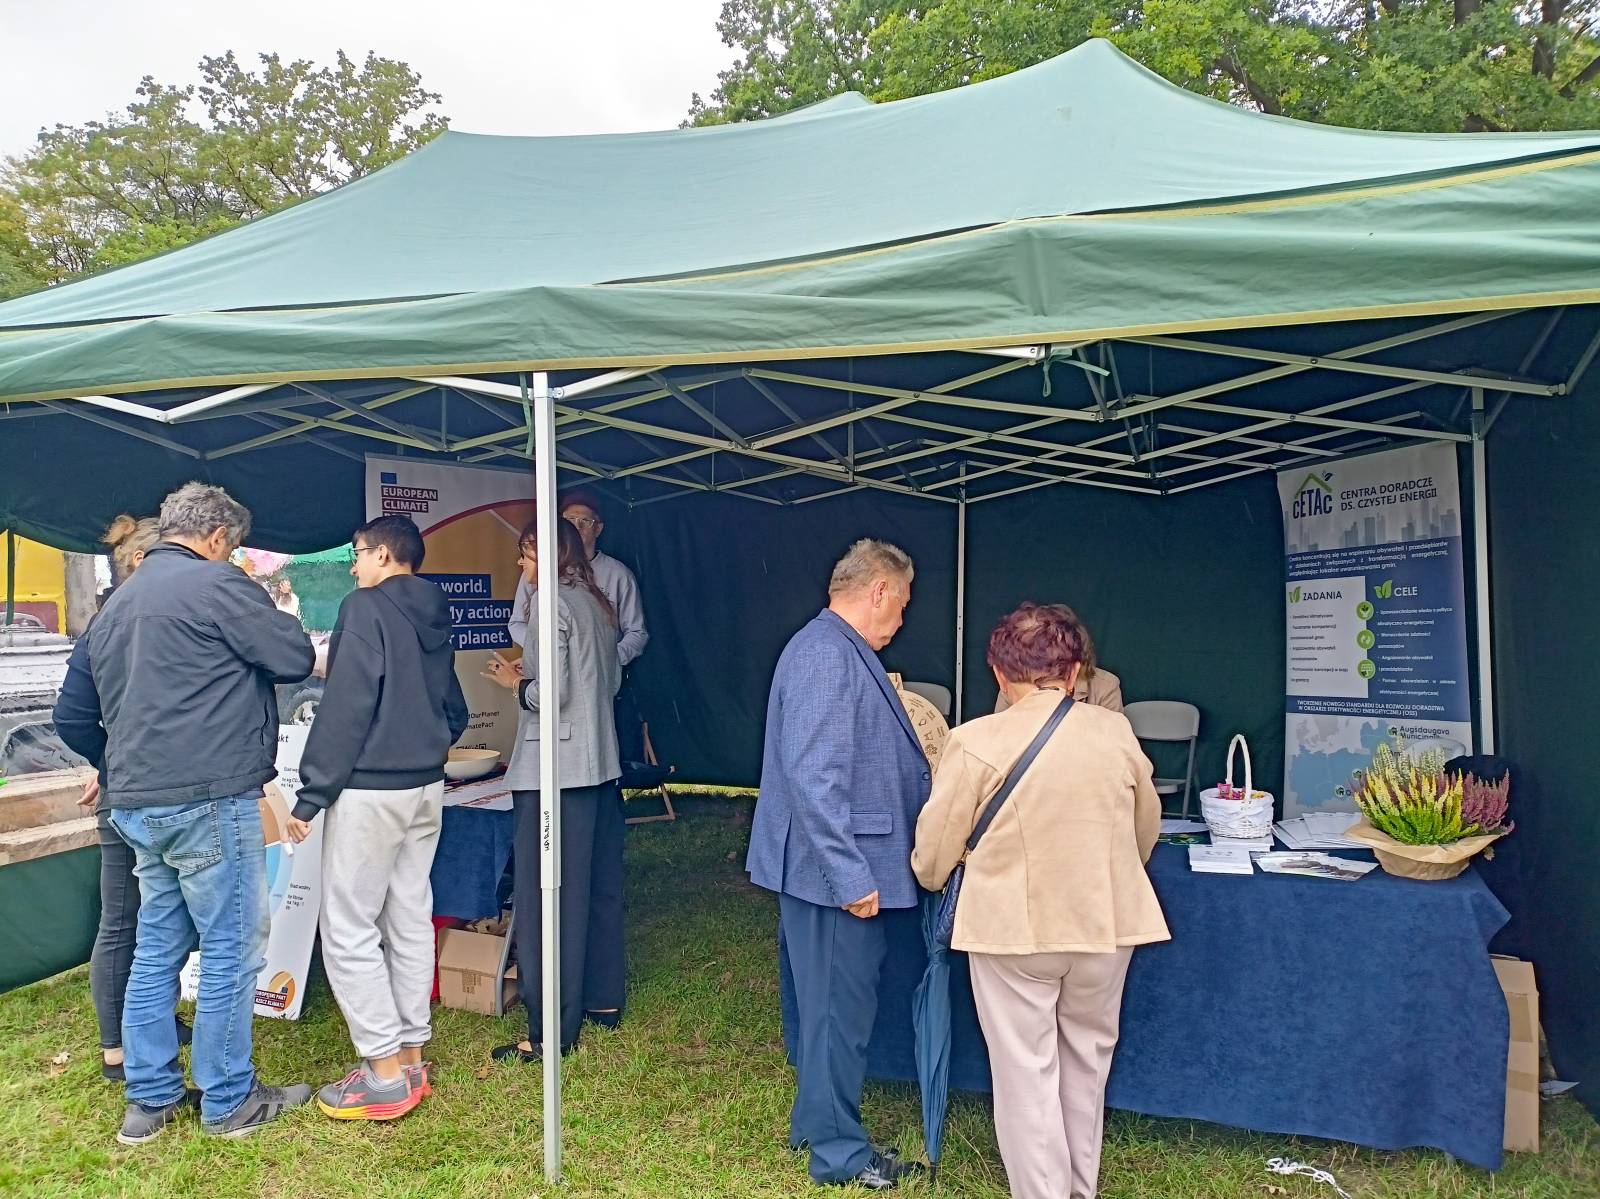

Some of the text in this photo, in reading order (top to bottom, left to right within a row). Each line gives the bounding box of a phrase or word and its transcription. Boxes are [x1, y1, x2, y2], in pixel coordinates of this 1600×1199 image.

[383, 487, 437, 499] EUROPEAN
[1340, 477, 1433, 500] CENTRA DORADCZE
[383, 500, 428, 511] CLIMATE
[1293, 488, 1333, 519] CETAC
[1341, 488, 1437, 511] DS. CZYSTEJ ENERGII
[441, 579, 487, 593] world.
[1393, 586, 1418, 597] CELE
[1303, 590, 1343, 601] ZADANIA
[467, 605, 511, 619] action
[459, 630, 508, 649] planet.
